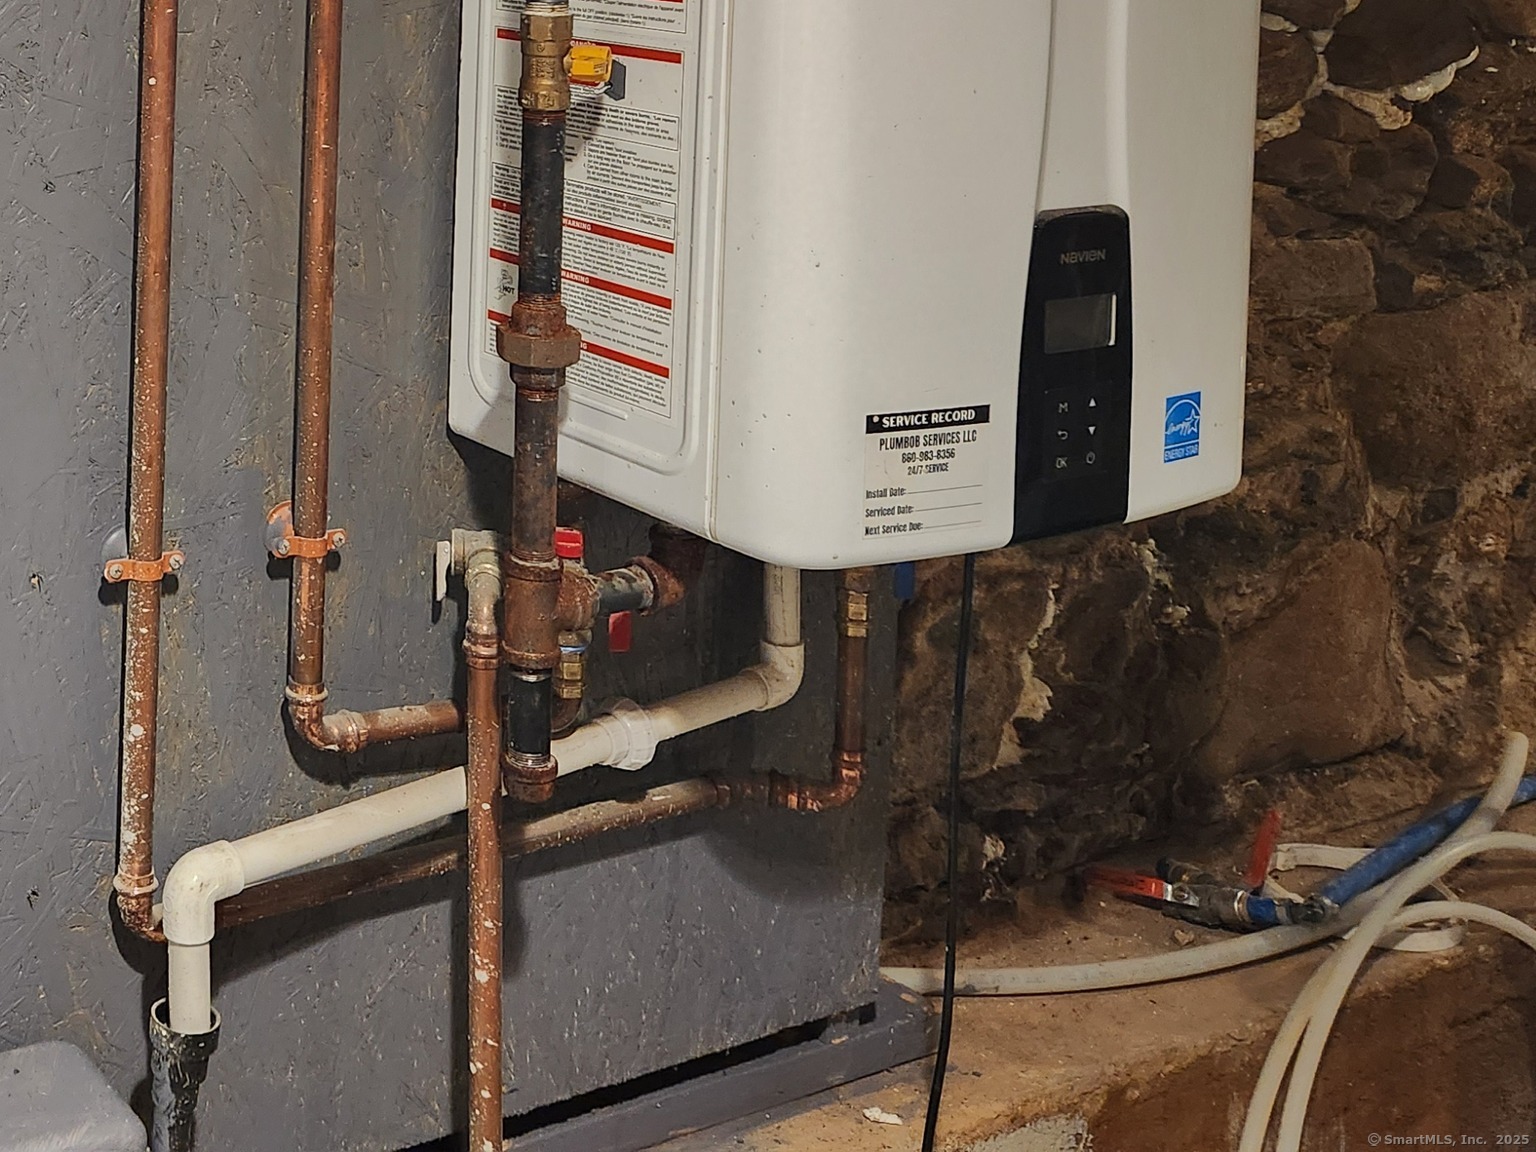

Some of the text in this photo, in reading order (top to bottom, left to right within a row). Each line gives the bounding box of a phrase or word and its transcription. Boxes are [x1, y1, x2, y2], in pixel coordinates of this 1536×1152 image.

[881, 409, 976, 429] SERVICE RECORD
[879, 429, 977, 451] PLUMBOB SERVICES LLC
[907, 465, 924, 475] 24/7
[865, 487, 907, 499] Install Date:
[865, 505, 915, 518] Serviced Date:
[865, 525, 880, 536] Next
[882, 522, 907, 534] Service
